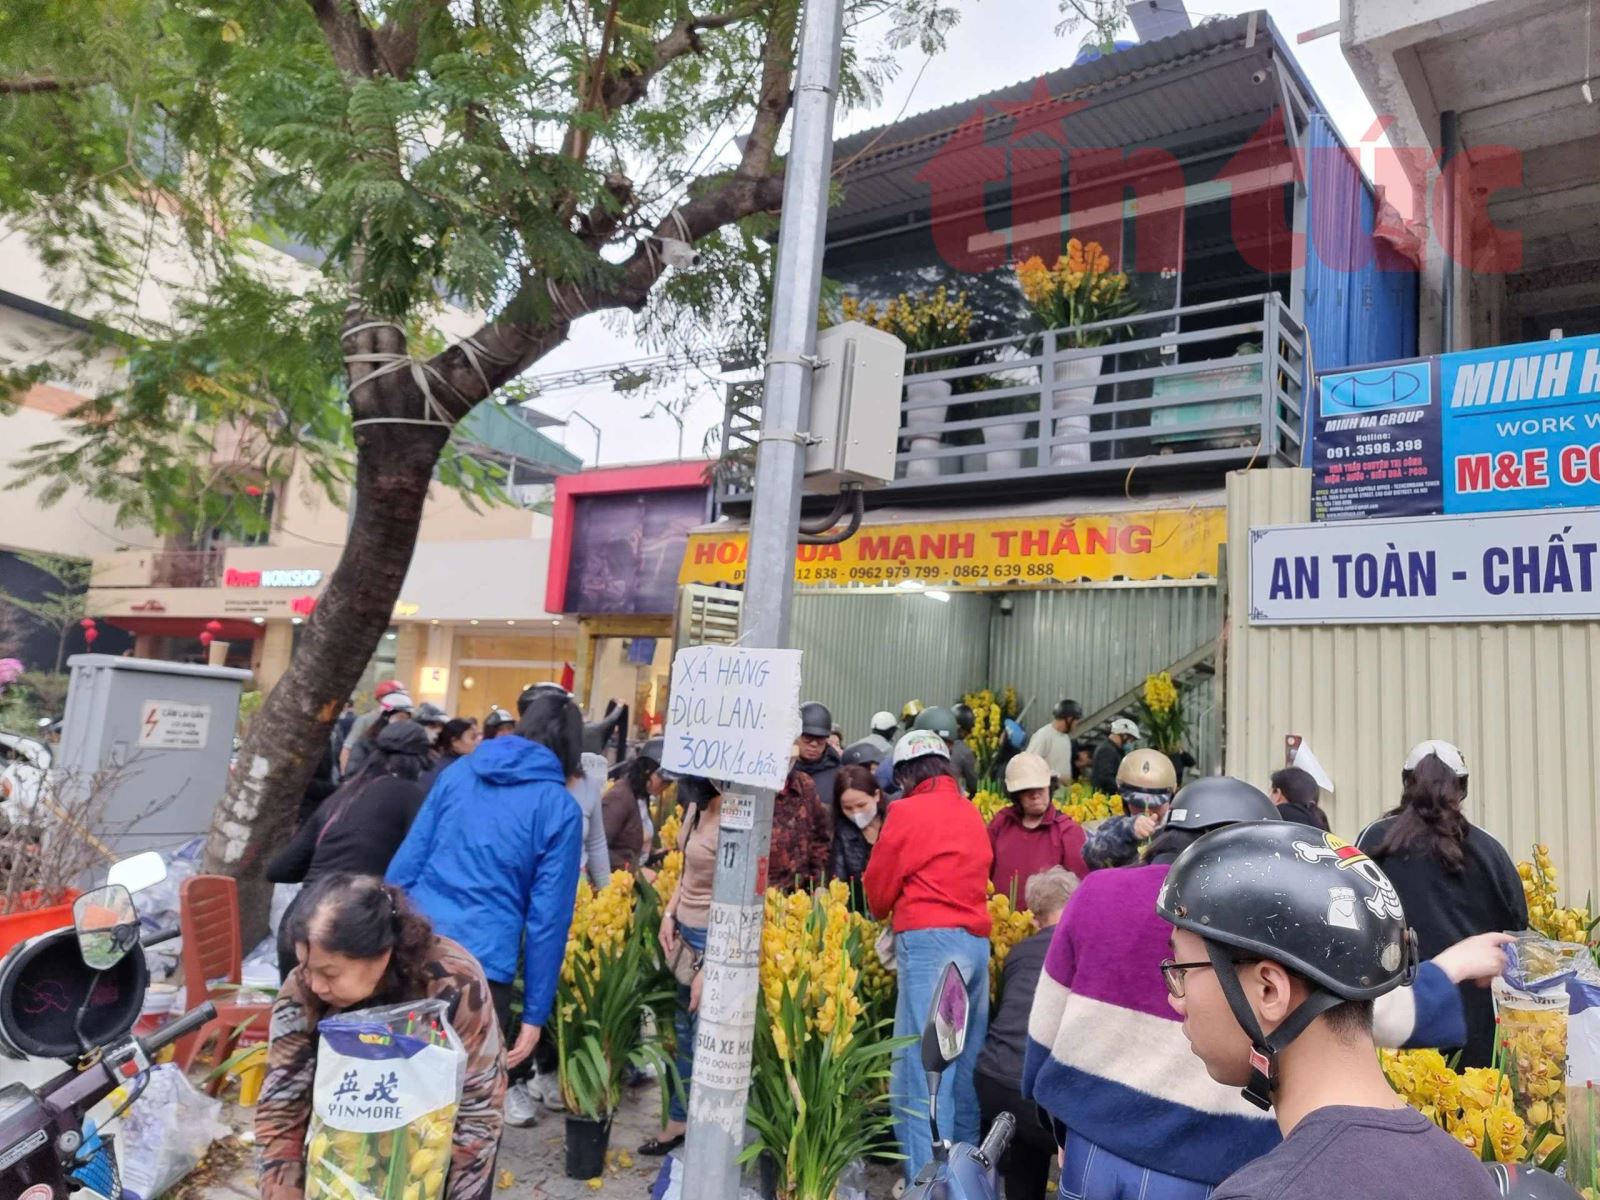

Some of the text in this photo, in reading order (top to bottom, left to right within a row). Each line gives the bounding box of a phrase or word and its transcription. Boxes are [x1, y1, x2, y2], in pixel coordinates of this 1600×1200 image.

[1451, 348, 1600, 408] MINH H
[1325, 411, 1424, 432] MINH HA GROUP
[1496, 413, 1600, 437] WORK W
[1356, 432, 1391, 443] Hotline:
[1326, 439, 1423, 459] 091.3598.398
[1455, 448, 1549, 494] M&E
[858, 533, 975, 565] MẠNH
[991, 517, 1153, 557] THẮNG
[815, 567, 838, 579] 838
[849, 566, 882, 579] 0962
[886, 566, 910, 578] 979
[914, 566, 940, 578] 799
[953, 565, 989, 577] 0862
[994, 564, 1021, 576] 639
[1026, 563, 1054, 575] 888
[1269, 556, 1319, 599] AN
[1332, 542, 1437, 599] TOÀN
[1482, 526, 1598, 596] CHẤT
[328, 1103, 404, 1119] YINMORE
